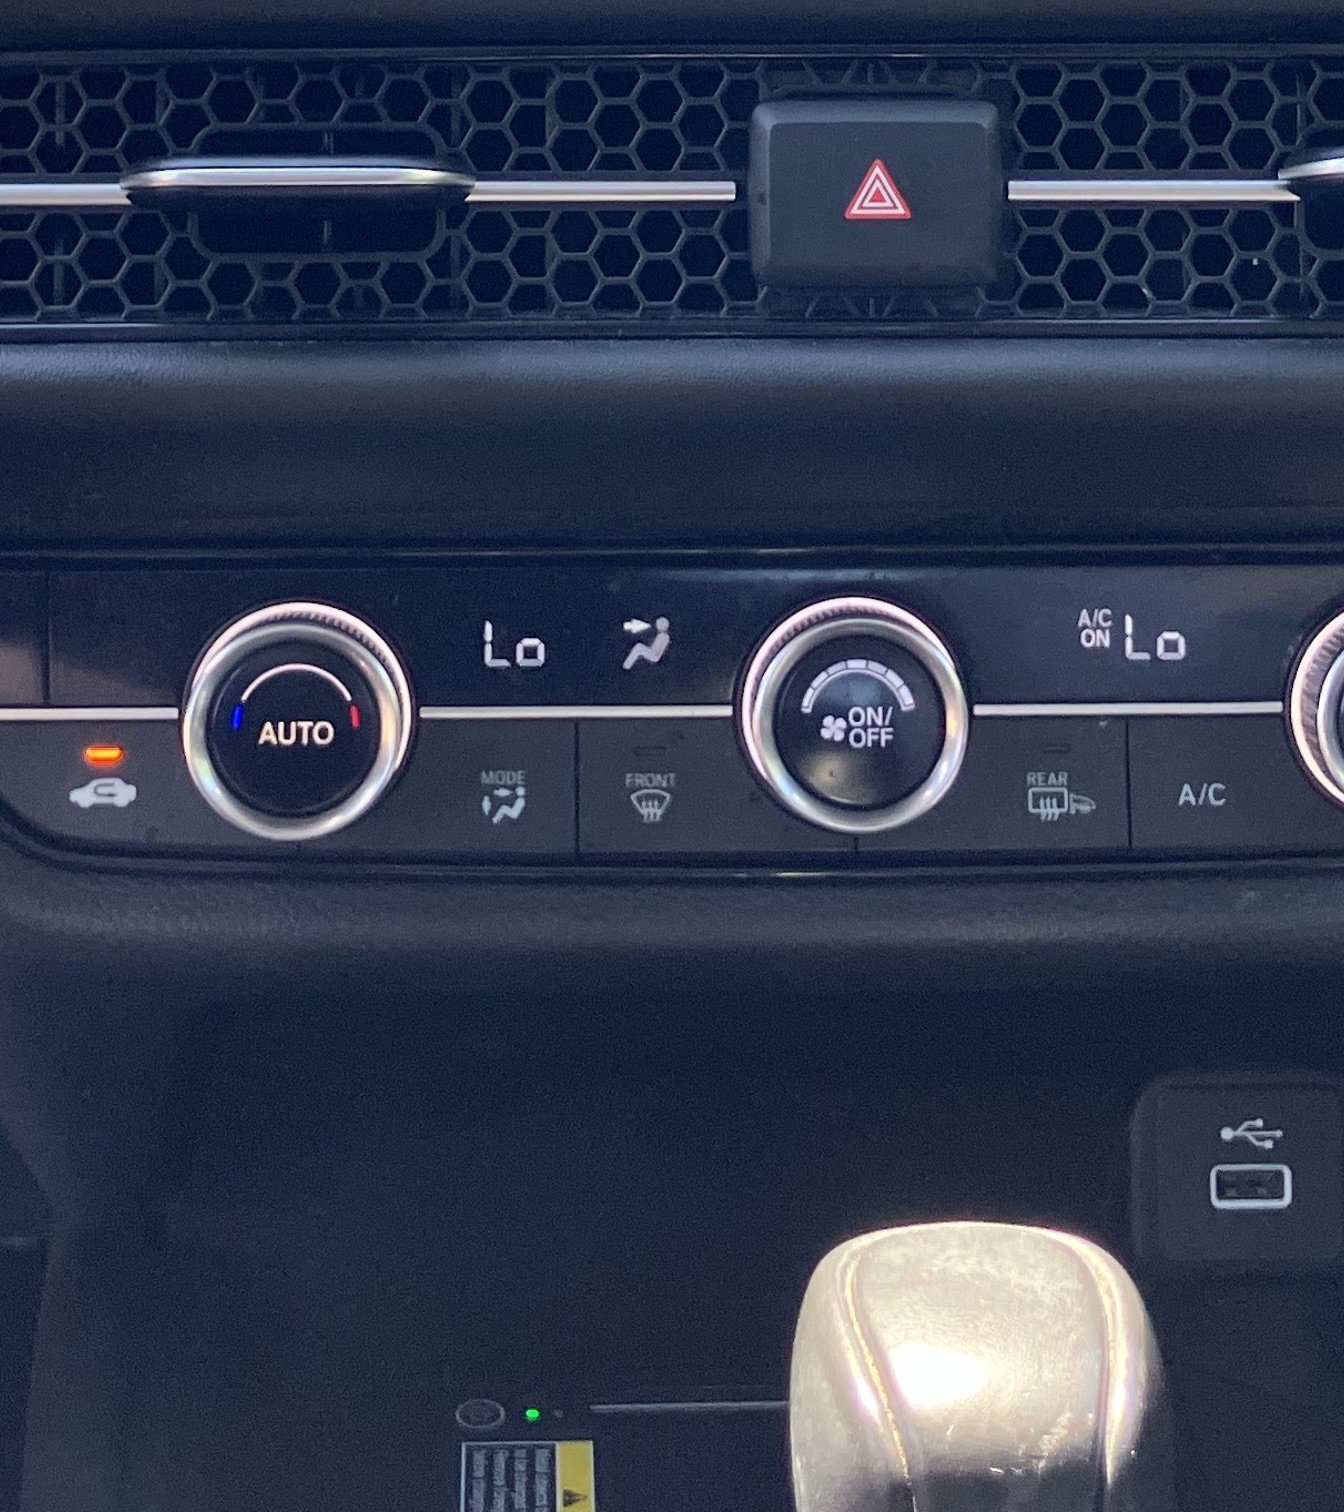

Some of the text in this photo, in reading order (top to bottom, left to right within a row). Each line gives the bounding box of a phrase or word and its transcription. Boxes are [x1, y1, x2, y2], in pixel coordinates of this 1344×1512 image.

[1077, 608, 1112, 628] A/C
[484, 621, 545, 667] Lo
[1080, 629, 1111, 648] ON
[1125, 615, 1185, 660] Lo
[848, 706, 893, 725] ON/
[259, 721, 334, 745] AUTO
[849, 728, 893, 749] OFF
[480, 770, 527, 788] MODE
[624, 772, 677, 790] FRONT
[1026, 772, 1070, 788] REAR
[1179, 783, 1225, 806] A/C
